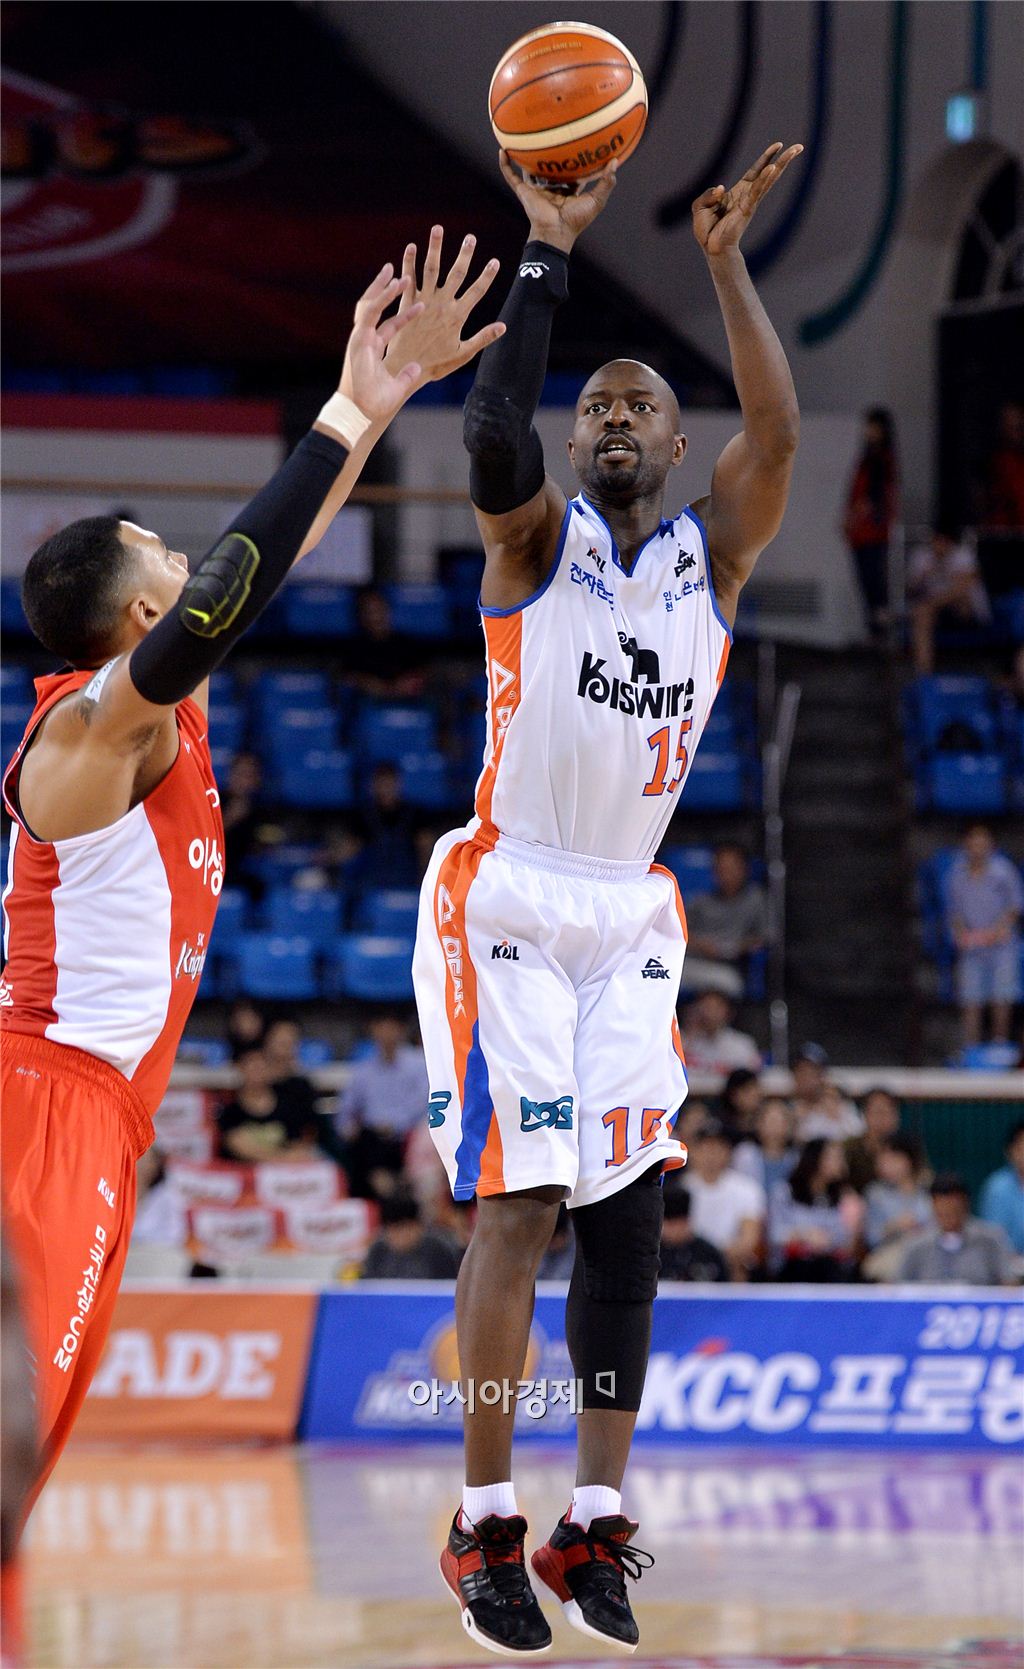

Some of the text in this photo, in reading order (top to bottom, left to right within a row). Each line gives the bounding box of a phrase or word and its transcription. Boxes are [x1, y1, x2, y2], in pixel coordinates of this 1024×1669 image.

[537, 132, 625, 173] molten
[642, 716, 694, 797] 15
[491, 940, 520, 961] KBL
[641, 968, 671, 980] PEAK
[635, 1351, 821, 1434] KCC
